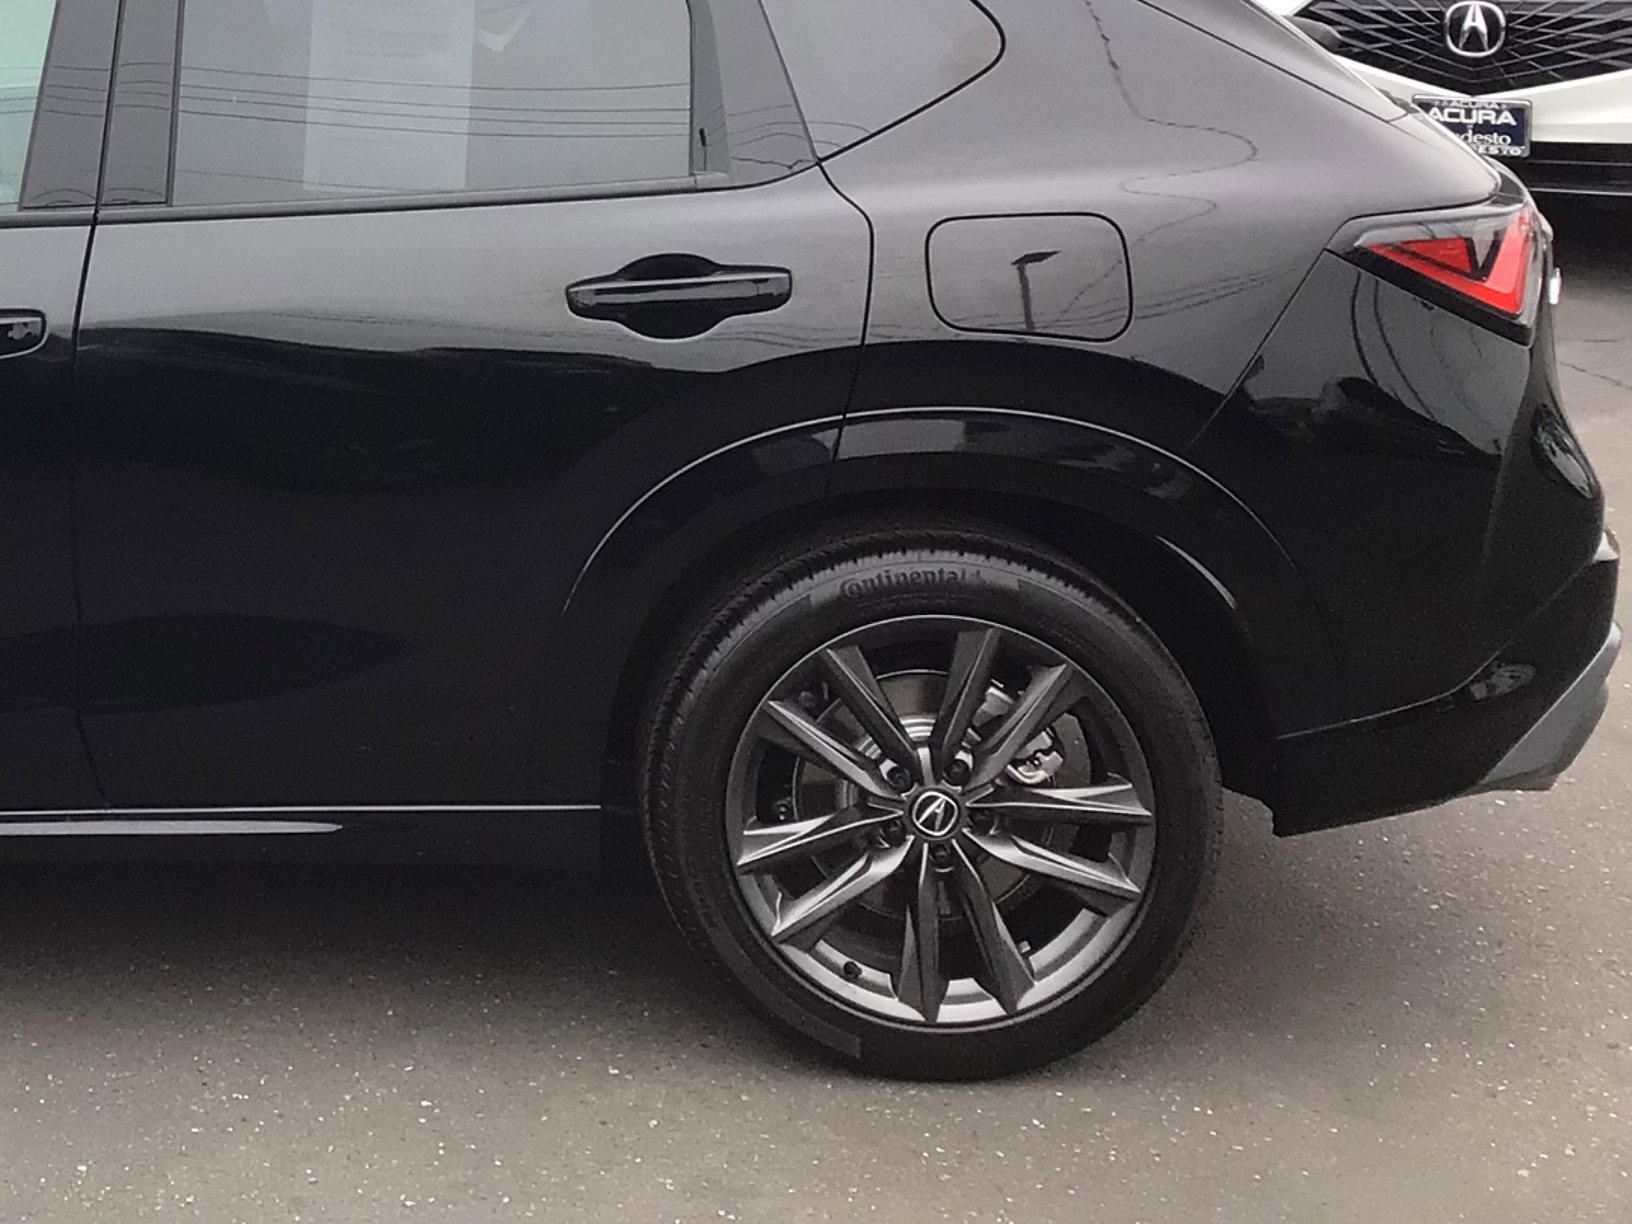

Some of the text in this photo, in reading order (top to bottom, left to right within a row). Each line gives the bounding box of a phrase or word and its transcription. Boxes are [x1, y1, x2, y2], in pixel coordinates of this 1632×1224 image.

[1428, 107, 1517, 126] ACURA
[1456, 128, 1512, 146] desto
[839, 568, 969, 598] Continental
